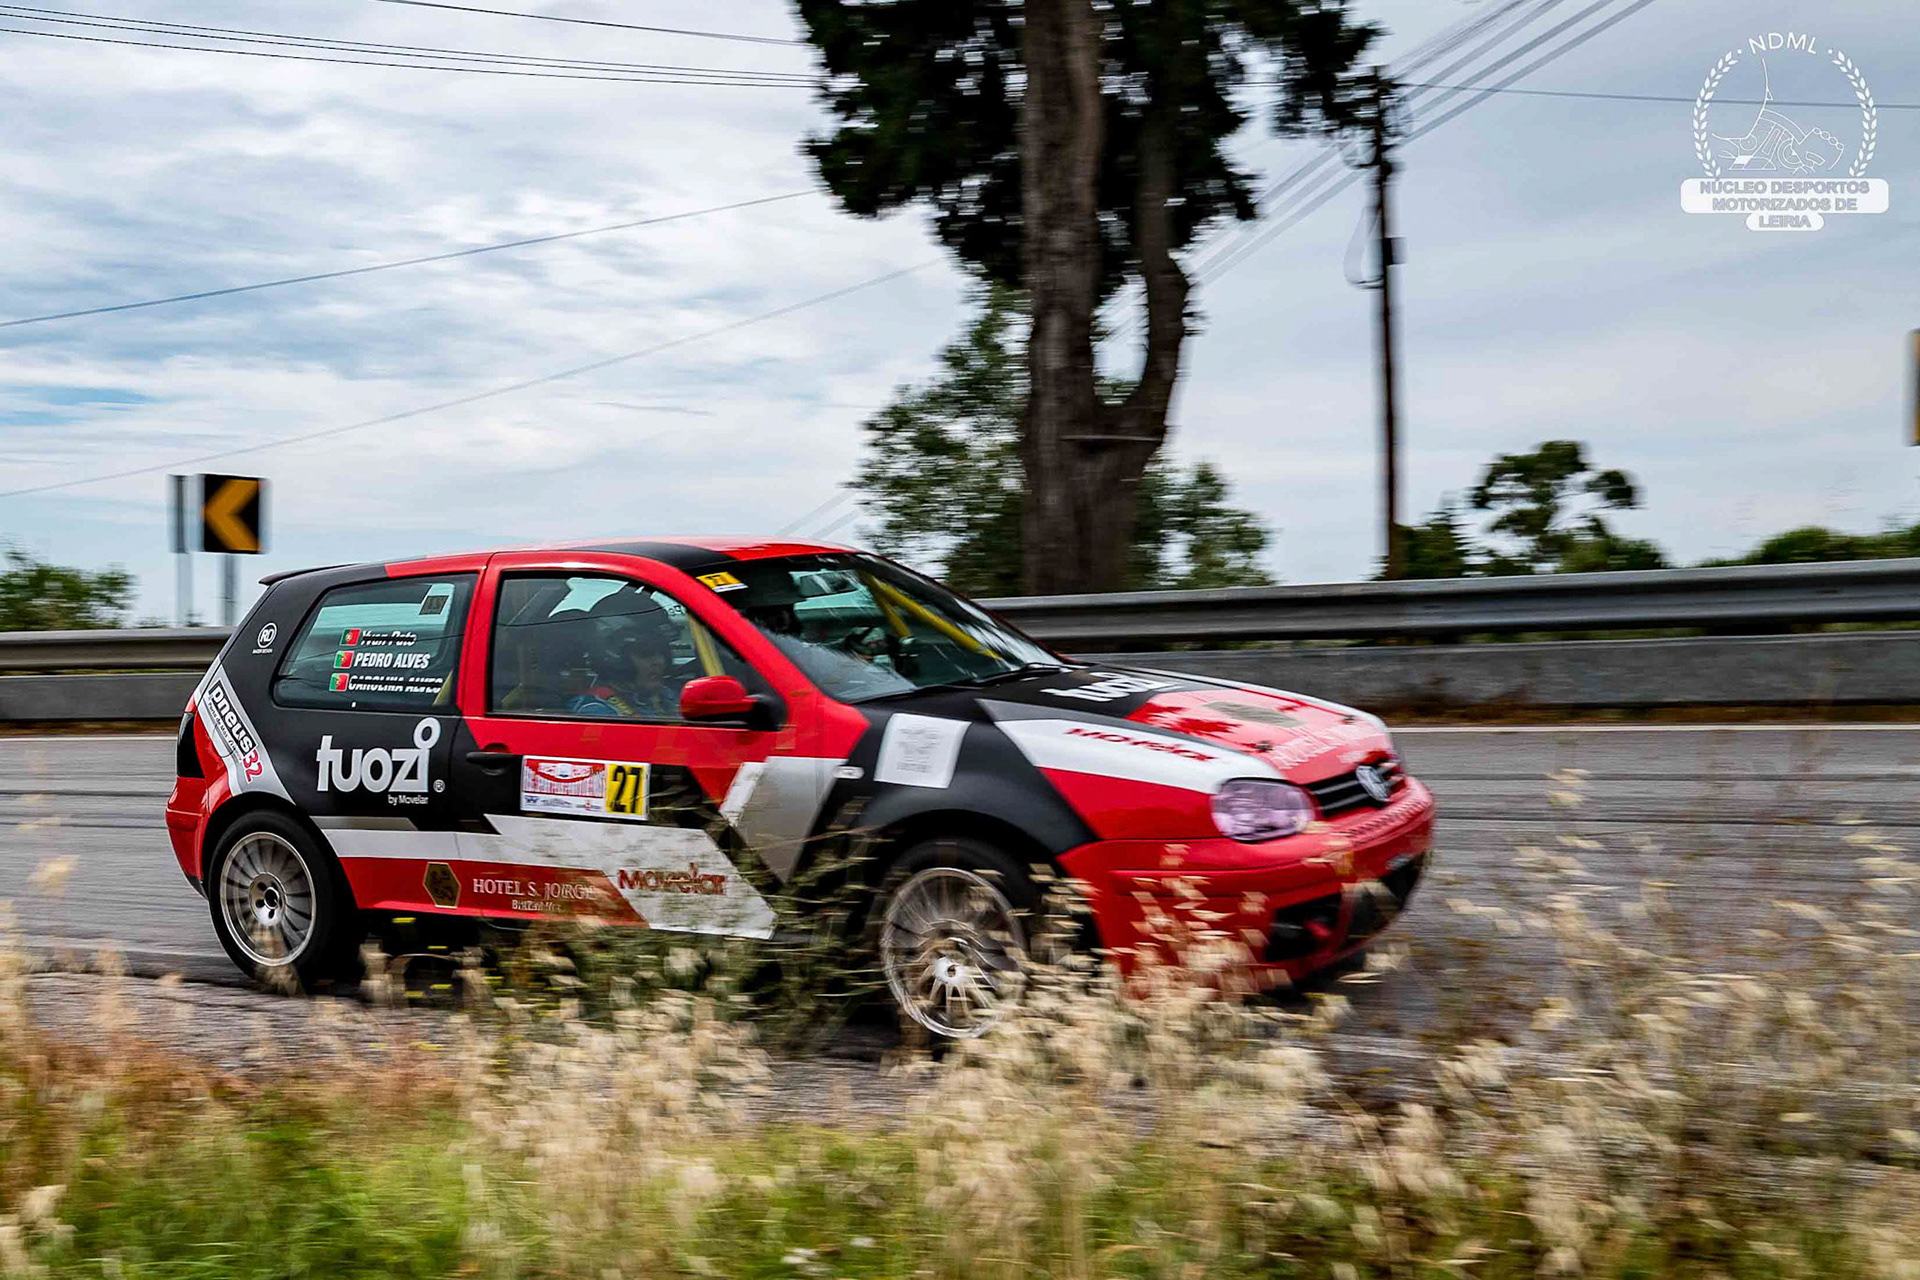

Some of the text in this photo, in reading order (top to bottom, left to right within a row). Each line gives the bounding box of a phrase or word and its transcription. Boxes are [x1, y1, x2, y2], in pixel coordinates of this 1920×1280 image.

[354, 653, 431, 669] PEDRO ALVES
[611, 765, 643, 814] 27
[388, 794, 398, 806] by
[473, 878, 524, 896] HOTEL
[528, 882, 541, 897] S.
